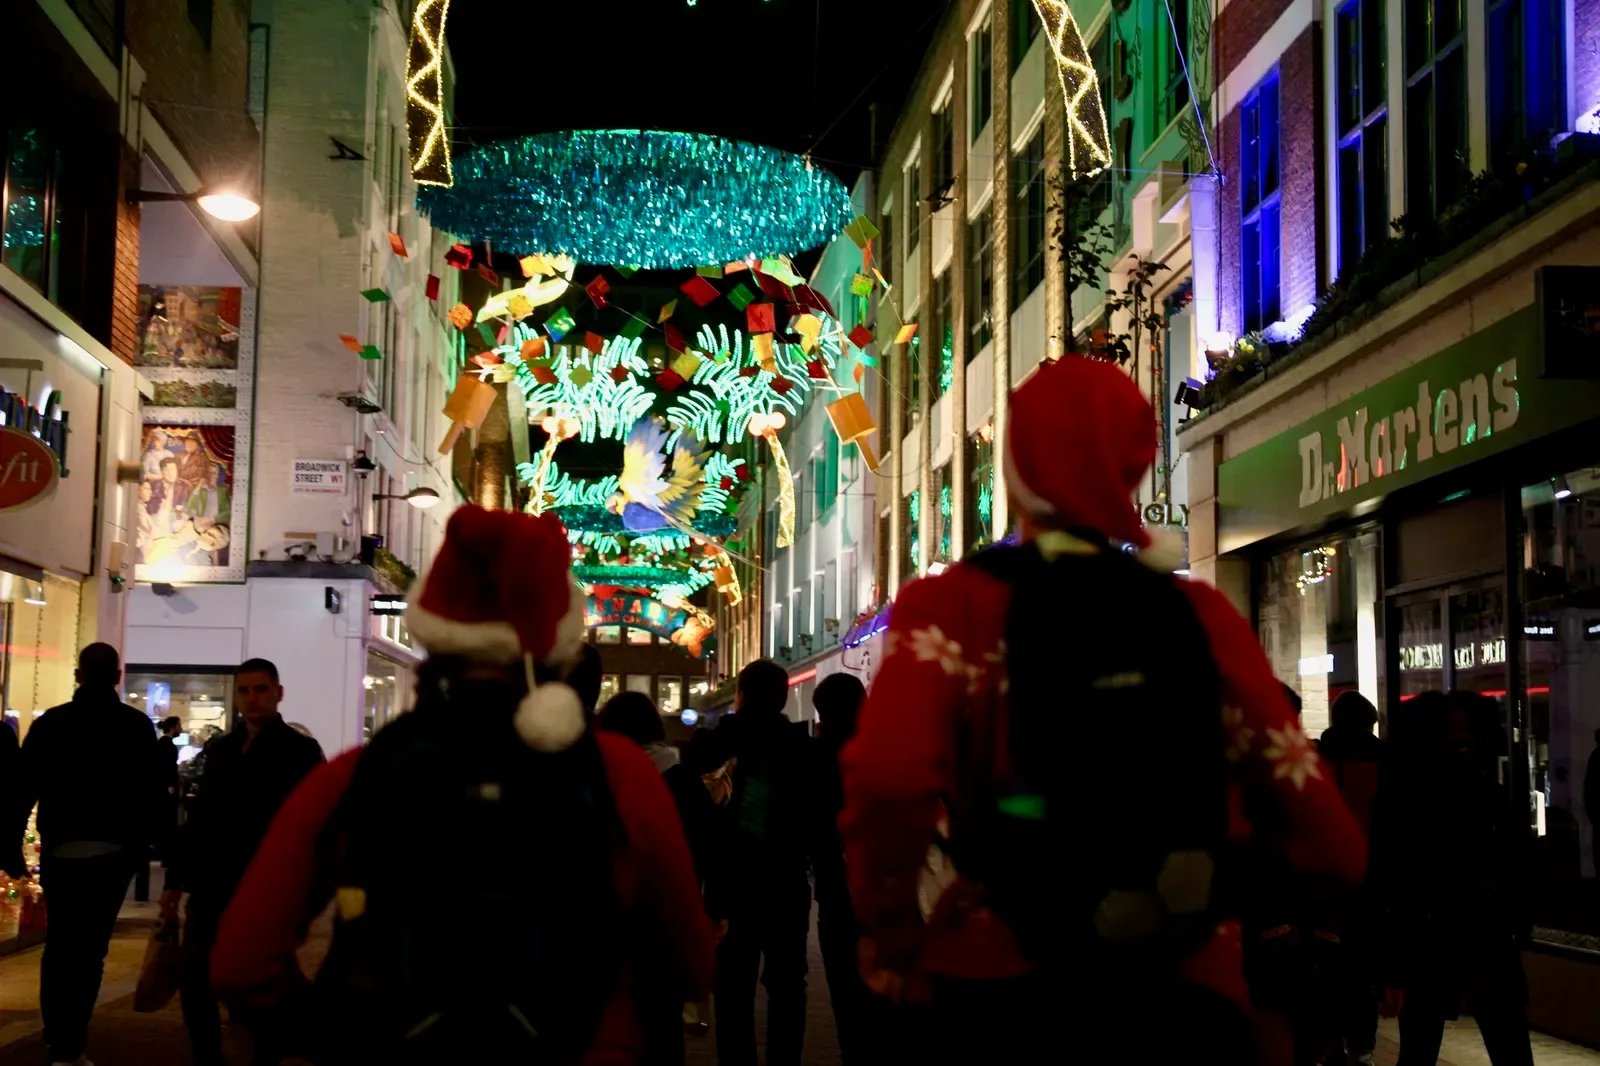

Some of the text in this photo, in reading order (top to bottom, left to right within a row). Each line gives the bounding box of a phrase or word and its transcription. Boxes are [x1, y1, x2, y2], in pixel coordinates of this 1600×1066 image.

[1337, 358, 1519, 492] Martens
[0, 450, 40, 488] fit
[295, 462, 341, 472] BROADWICK
[295, 473, 343, 484] STREET W1
[1134, 503, 1189, 526] GLY
